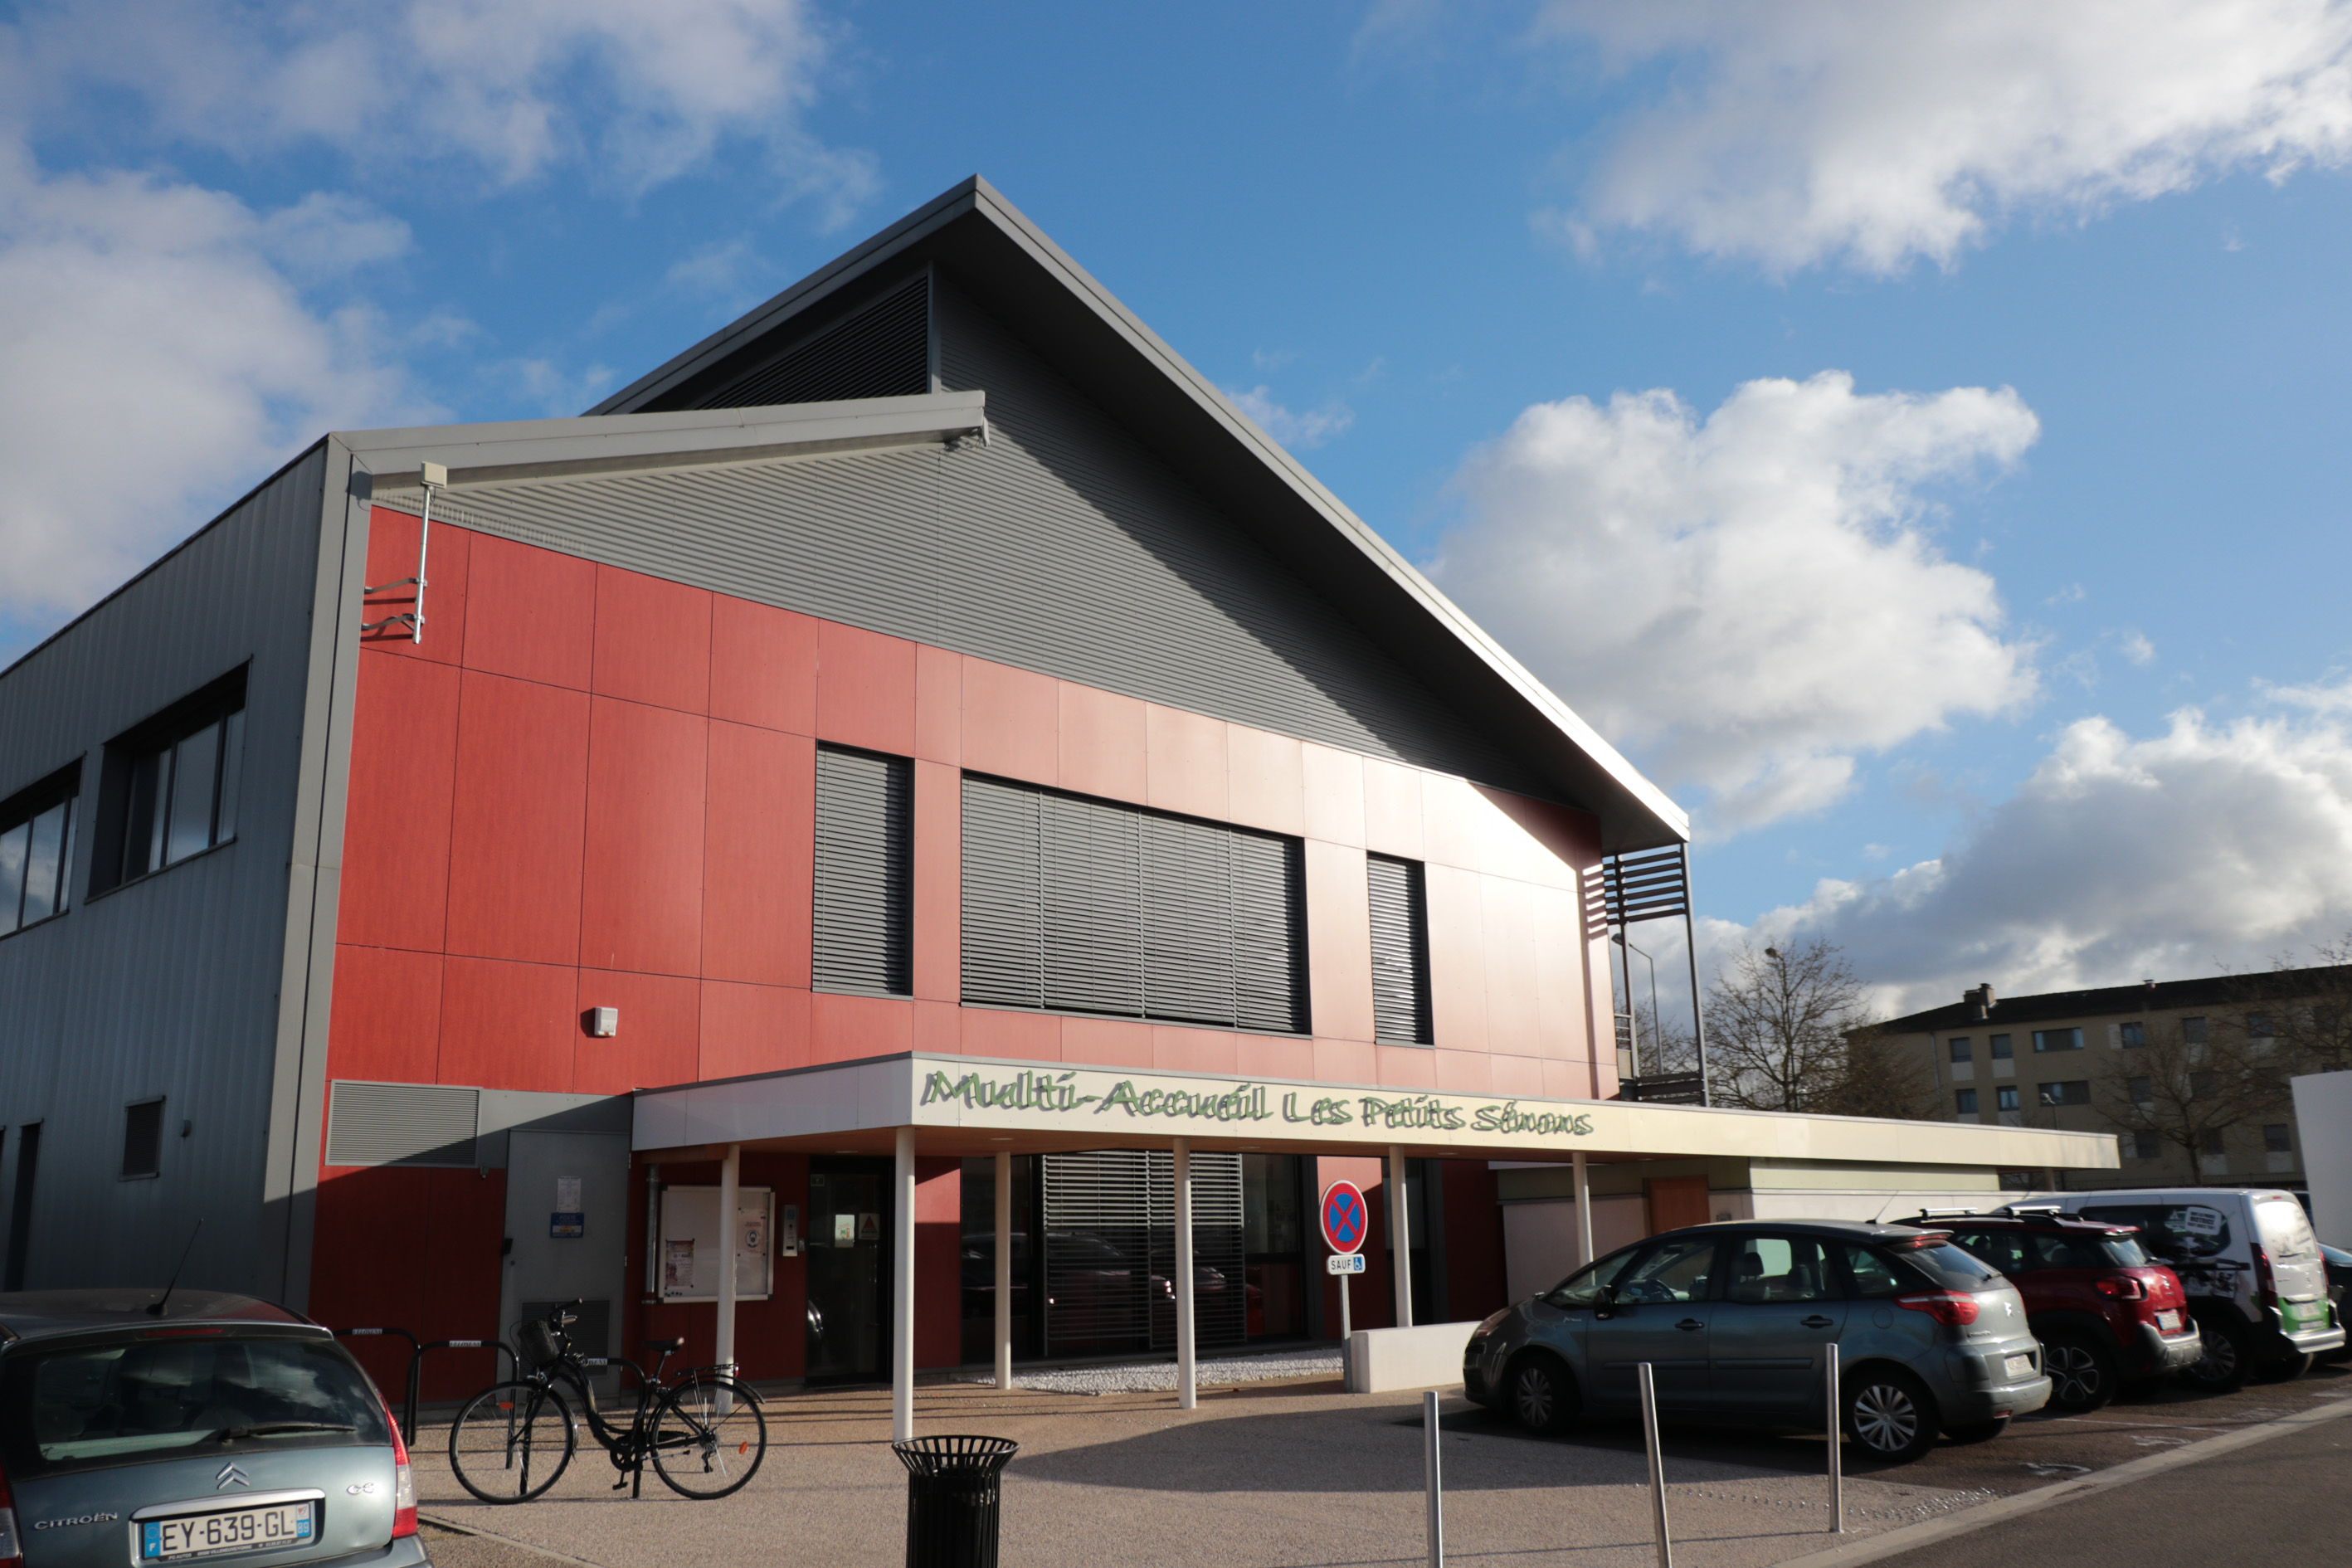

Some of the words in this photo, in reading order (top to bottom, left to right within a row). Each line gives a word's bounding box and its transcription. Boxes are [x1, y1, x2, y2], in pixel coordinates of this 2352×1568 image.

[928, 1070, 1274, 1118] Multi-Accueil
[1287, 1092, 1353, 1123] Les
[1363, 1095, 1466, 1129] Petits
[1331, 1259, 1351, 1270] SAUF
[34, 1512, 118, 1530] CITROËN
[297, 1521, 310, 1534] 89
[163, 1510, 295, 1551] EY-639-GL
[149, 1542, 156, 1552] F
